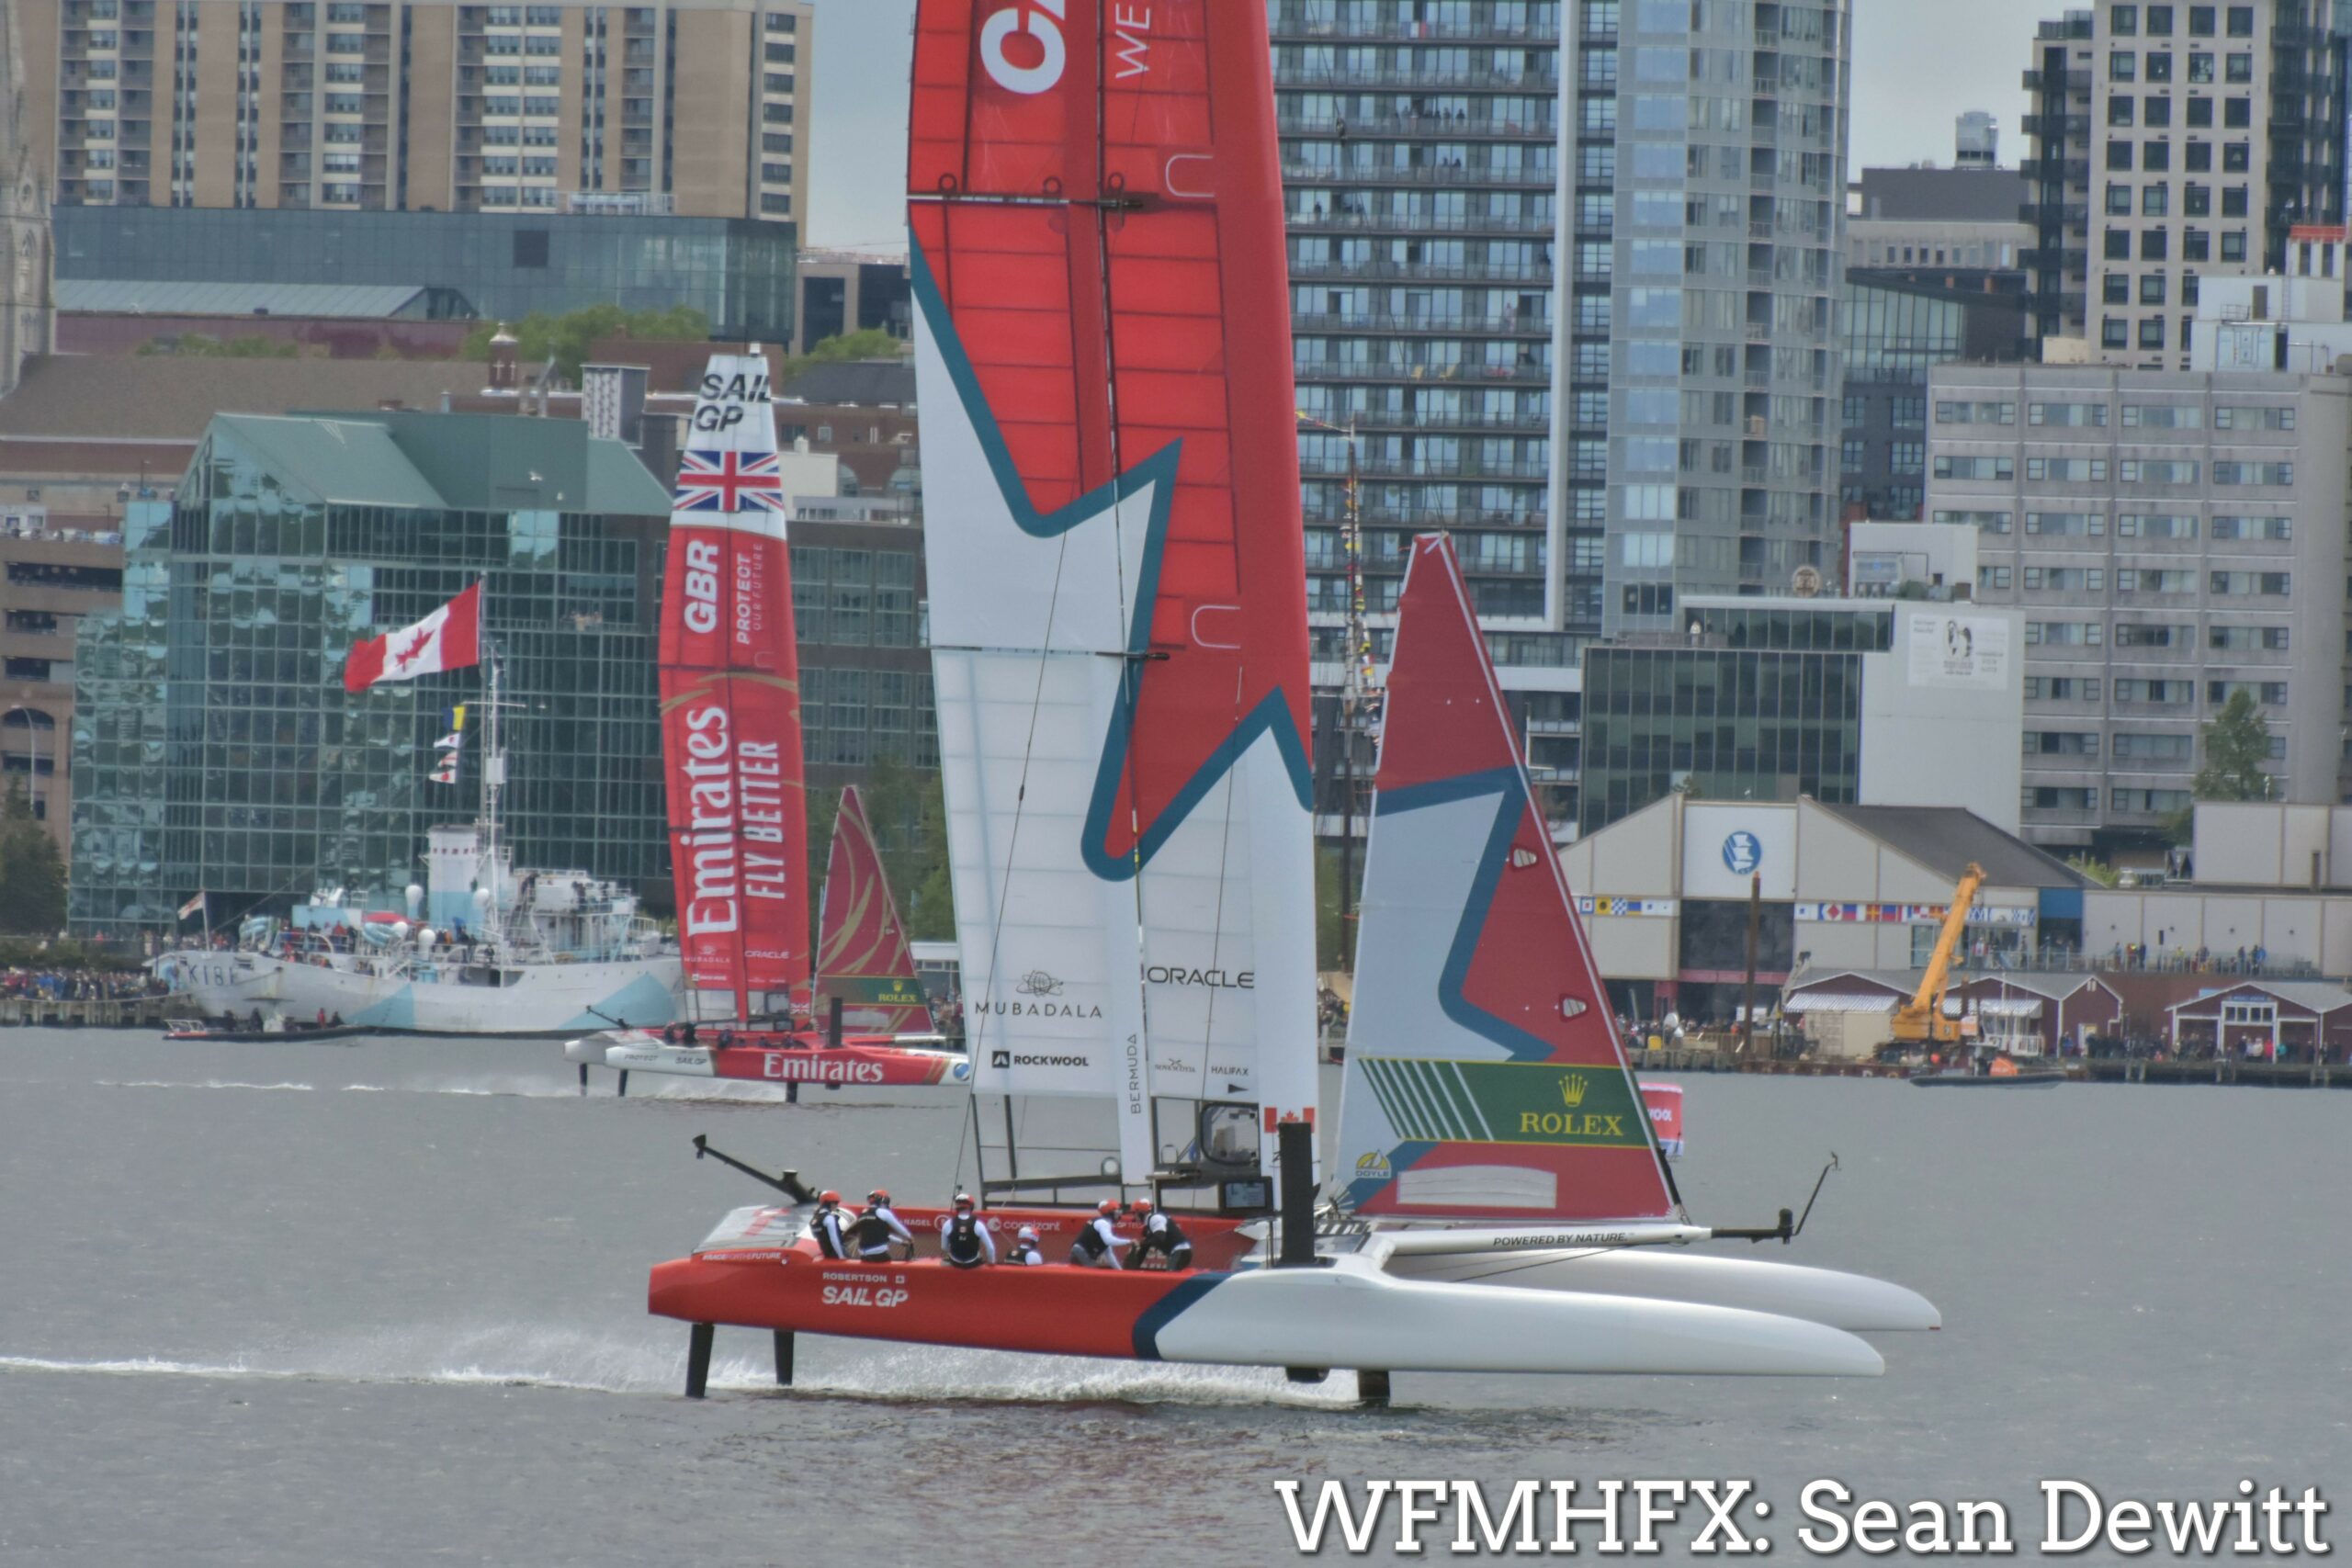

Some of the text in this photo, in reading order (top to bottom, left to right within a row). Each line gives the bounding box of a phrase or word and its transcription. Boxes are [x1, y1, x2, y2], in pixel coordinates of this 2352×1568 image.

[700, 374, 771, 402] SAIL
[695, 405, 743, 432] GP
[684, 540, 718, 634] GBR
[737, 554, 750, 645] PROTECT
[752, 543, 763, 631] OUR FUTURE
[680, 706, 738, 937] Emirates
[739, 741, 786, 899] FLY BETTER
[745, 950, 789, 959] ORACLE
[1148, 966, 1255, 989] ORACLE
[878, 993, 916, 1002] ROLEX
[975, 1001, 1102, 1019] MUBADALA
[763, 1053, 884, 1083] Emirates
[1013, 1055, 1090, 1066] ROCKWOOL
[1211, 1066, 1250, 1076] HALIFAX
[1126, 1033, 1141, 1114] BERMUDA
[1520, 1112, 1624, 1136] ROLEX
[1493, 1235, 1555, 1247] POWERED
[1556, 1234, 1574, 1243] BY
[822, 1272, 888, 1282] ROBERTSON
